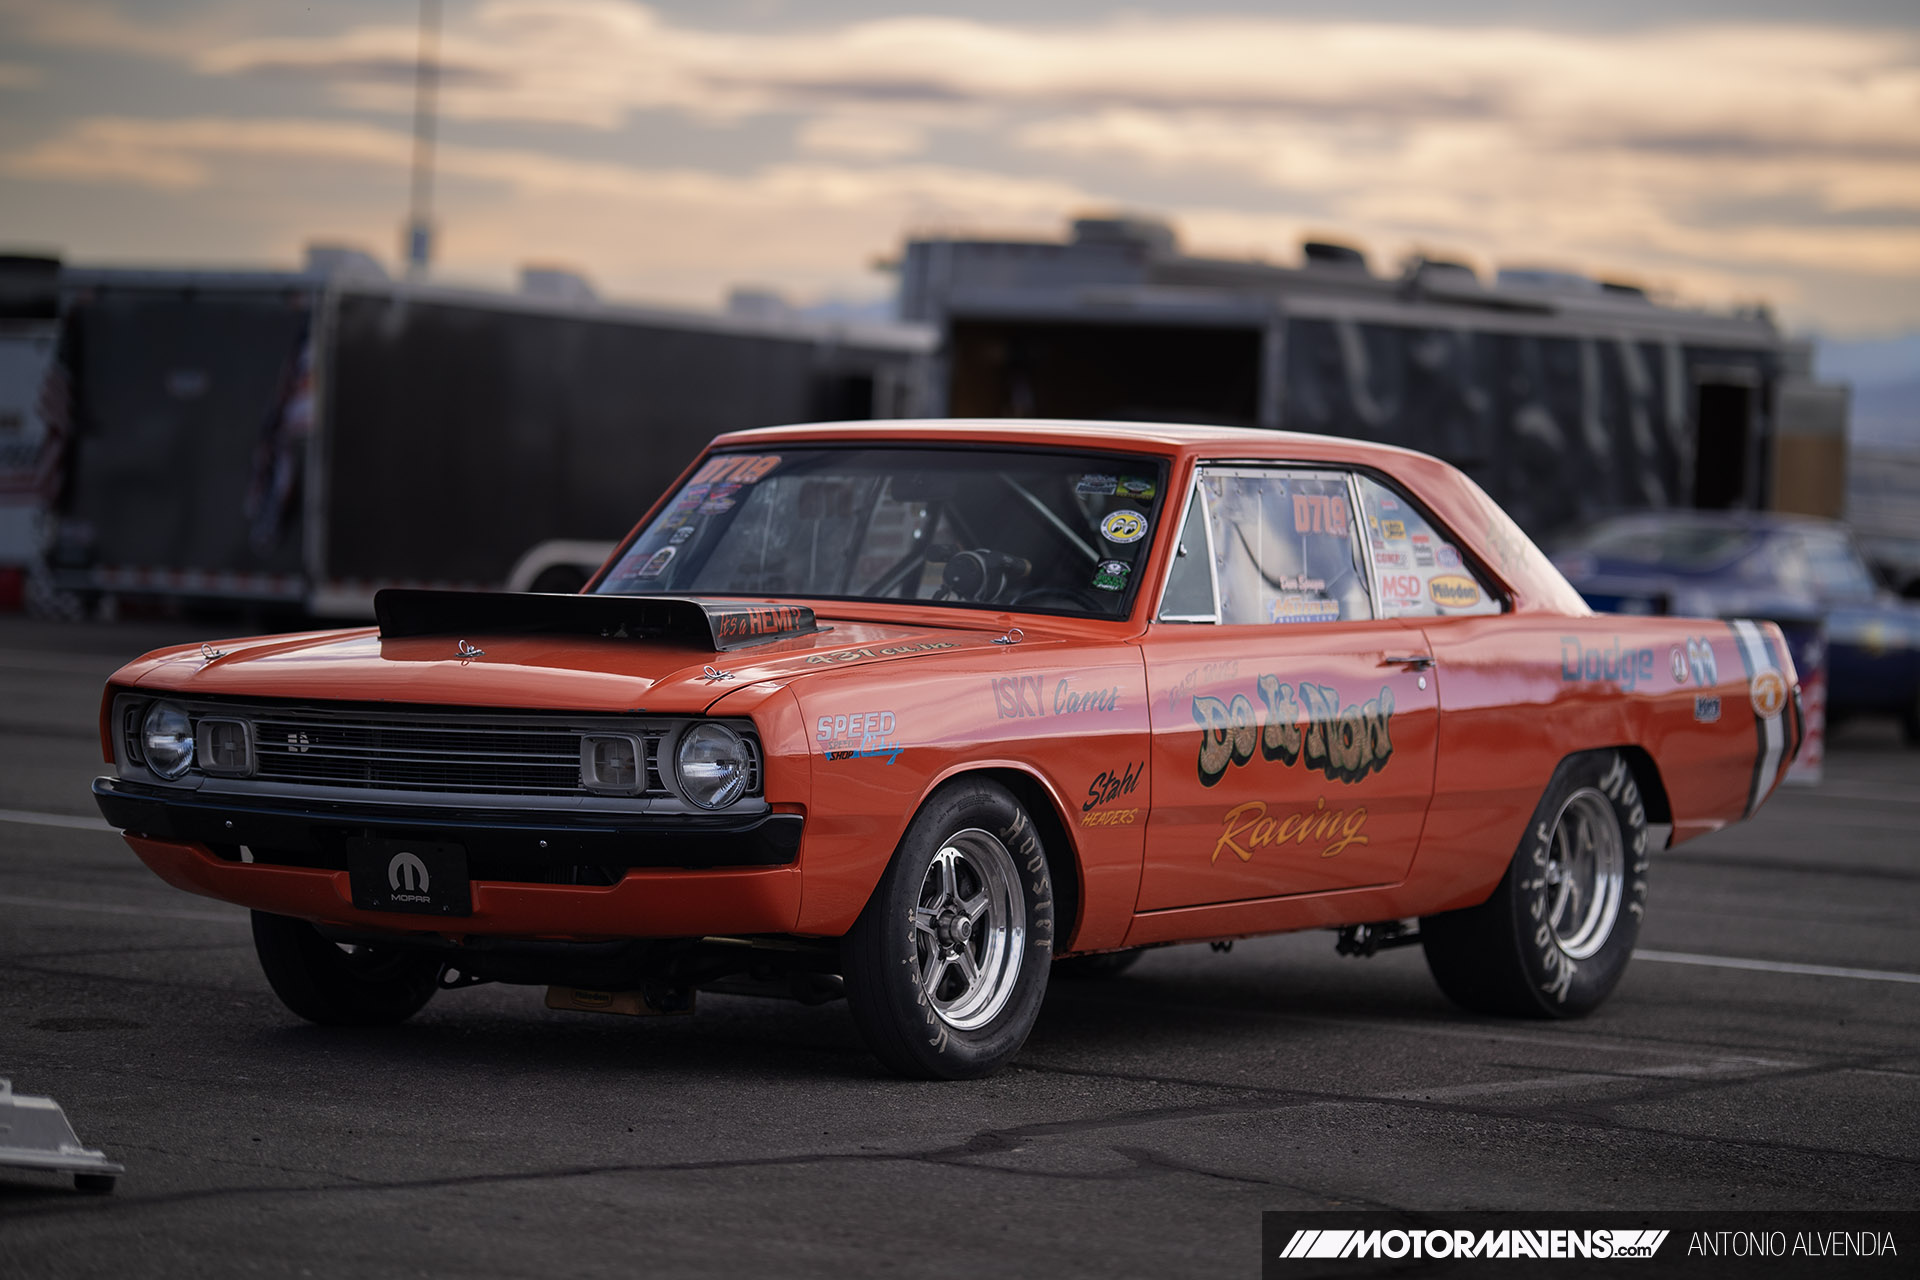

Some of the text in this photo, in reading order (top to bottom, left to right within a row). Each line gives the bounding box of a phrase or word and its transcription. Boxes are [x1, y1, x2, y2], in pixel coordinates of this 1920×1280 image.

[1383, 576, 1420, 599] MSD
[1432, 583, 1477, 600] Milodon
[739, 619, 747, 636] a
[746, 606, 801, 635] HEMI?
[806, 648, 877, 665] 431
[1560, 636, 1654, 692] Dodge
[992, 675, 1120, 719] ISKY Cams
[816, 710, 896, 741] SPEED
[829, 750, 854, 761] SHOP
[861, 733, 905, 766] City
[1082, 761, 1144, 811] Stahl
[1080, 808, 1138, 828] HEADERS
[1211, 795, 1369, 868] Racing
[391, 894, 431, 903] MOPAR
